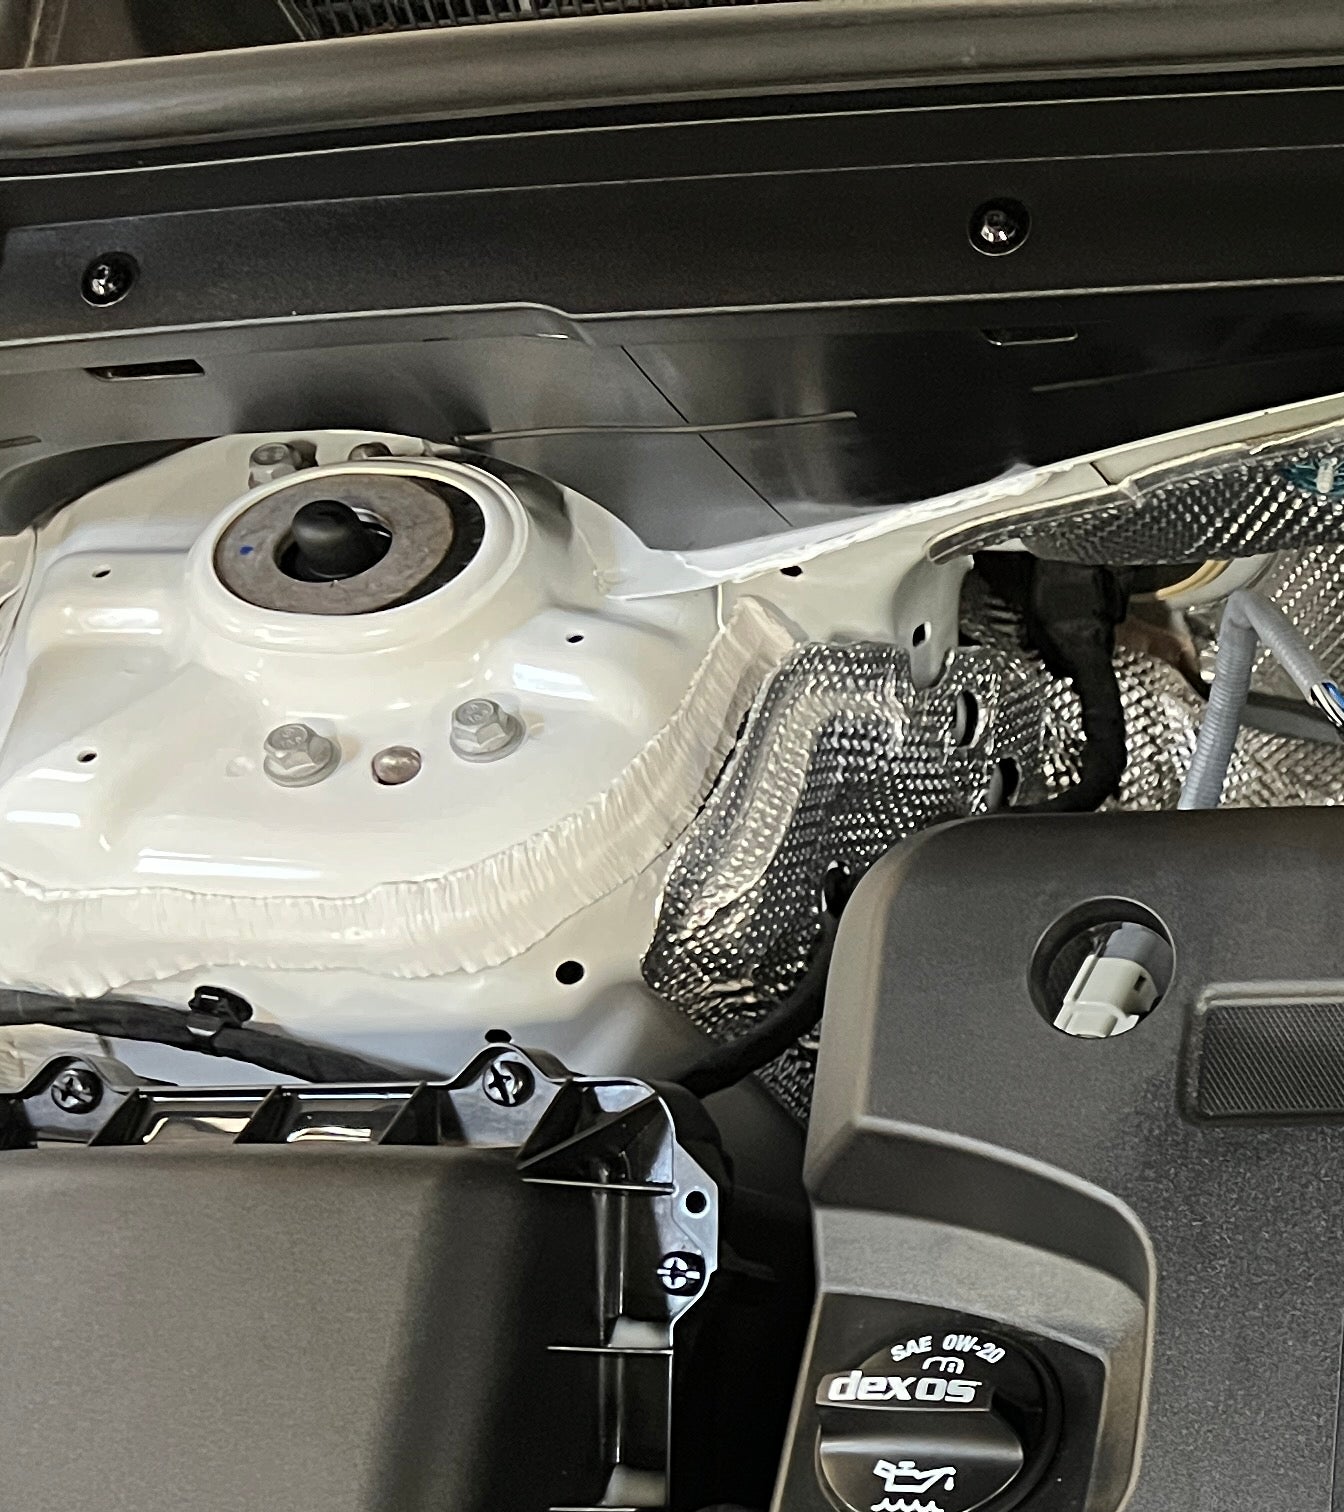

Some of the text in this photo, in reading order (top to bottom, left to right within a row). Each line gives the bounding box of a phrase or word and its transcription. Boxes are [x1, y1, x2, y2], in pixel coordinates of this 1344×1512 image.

[890, 1333, 1006, 1364] SAE 0W-20
[828, 1369, 983, 1403] dexos
